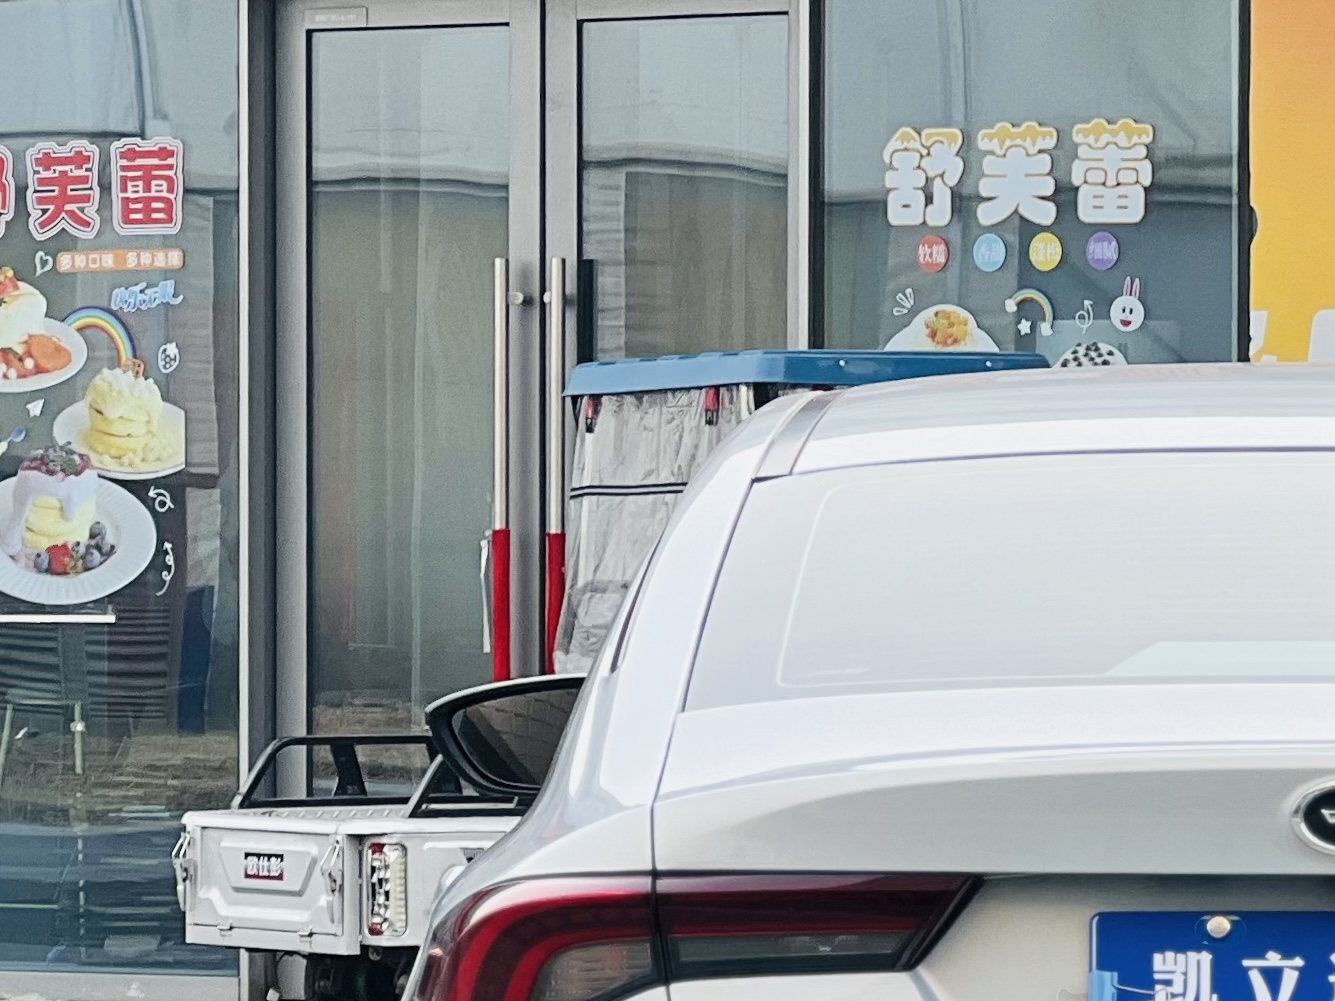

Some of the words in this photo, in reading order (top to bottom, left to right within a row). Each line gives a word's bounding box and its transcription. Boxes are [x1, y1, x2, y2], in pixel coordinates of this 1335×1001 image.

[0, 142, 180, 234] 芙蕾
[883, 118, 1154, 228] 舒芙蕾
[60, 252, 115, 271] 多种口味
